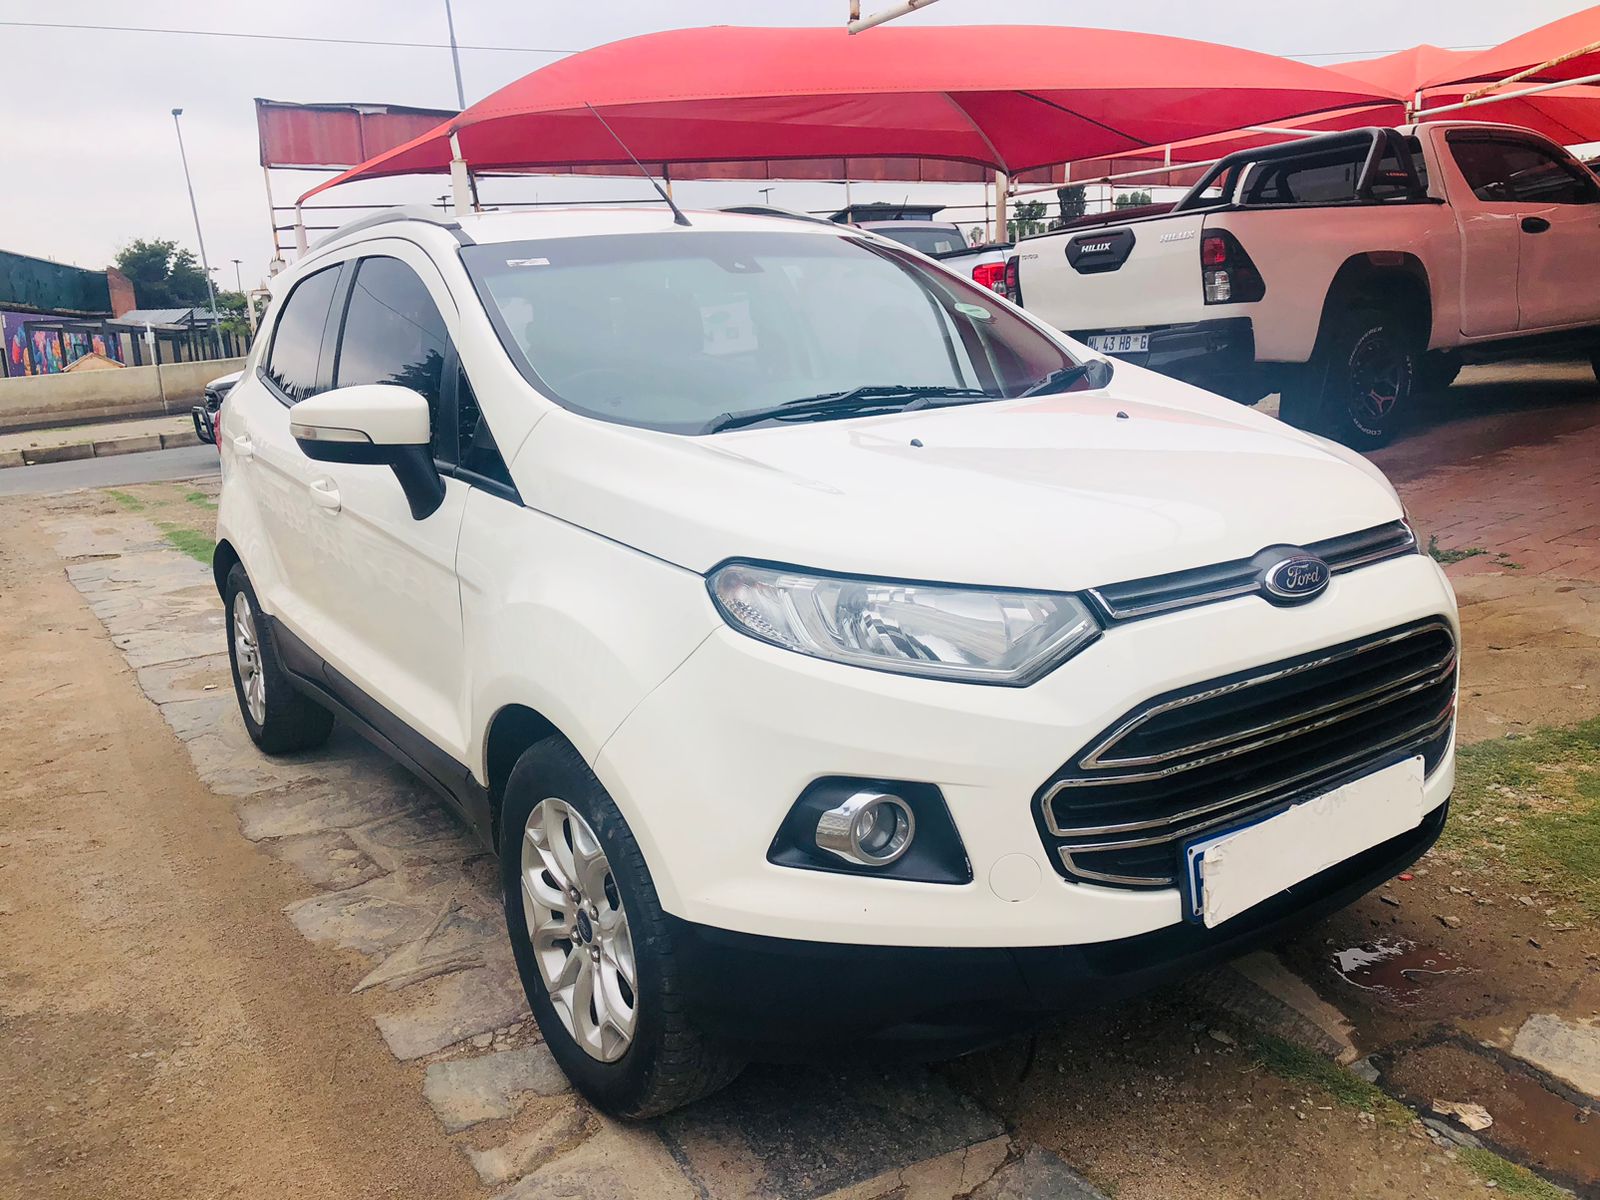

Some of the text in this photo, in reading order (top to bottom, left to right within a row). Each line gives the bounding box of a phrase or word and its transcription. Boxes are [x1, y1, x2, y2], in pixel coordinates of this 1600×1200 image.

[1159, 230, 1196, 243] HILUX
[1081, 242, 1112, 253] HILUX
[1103, 336, 1116, 351] 43
[1119, 335, 1132, 351] HB
[1286, 563, 1321, 589] Ford
